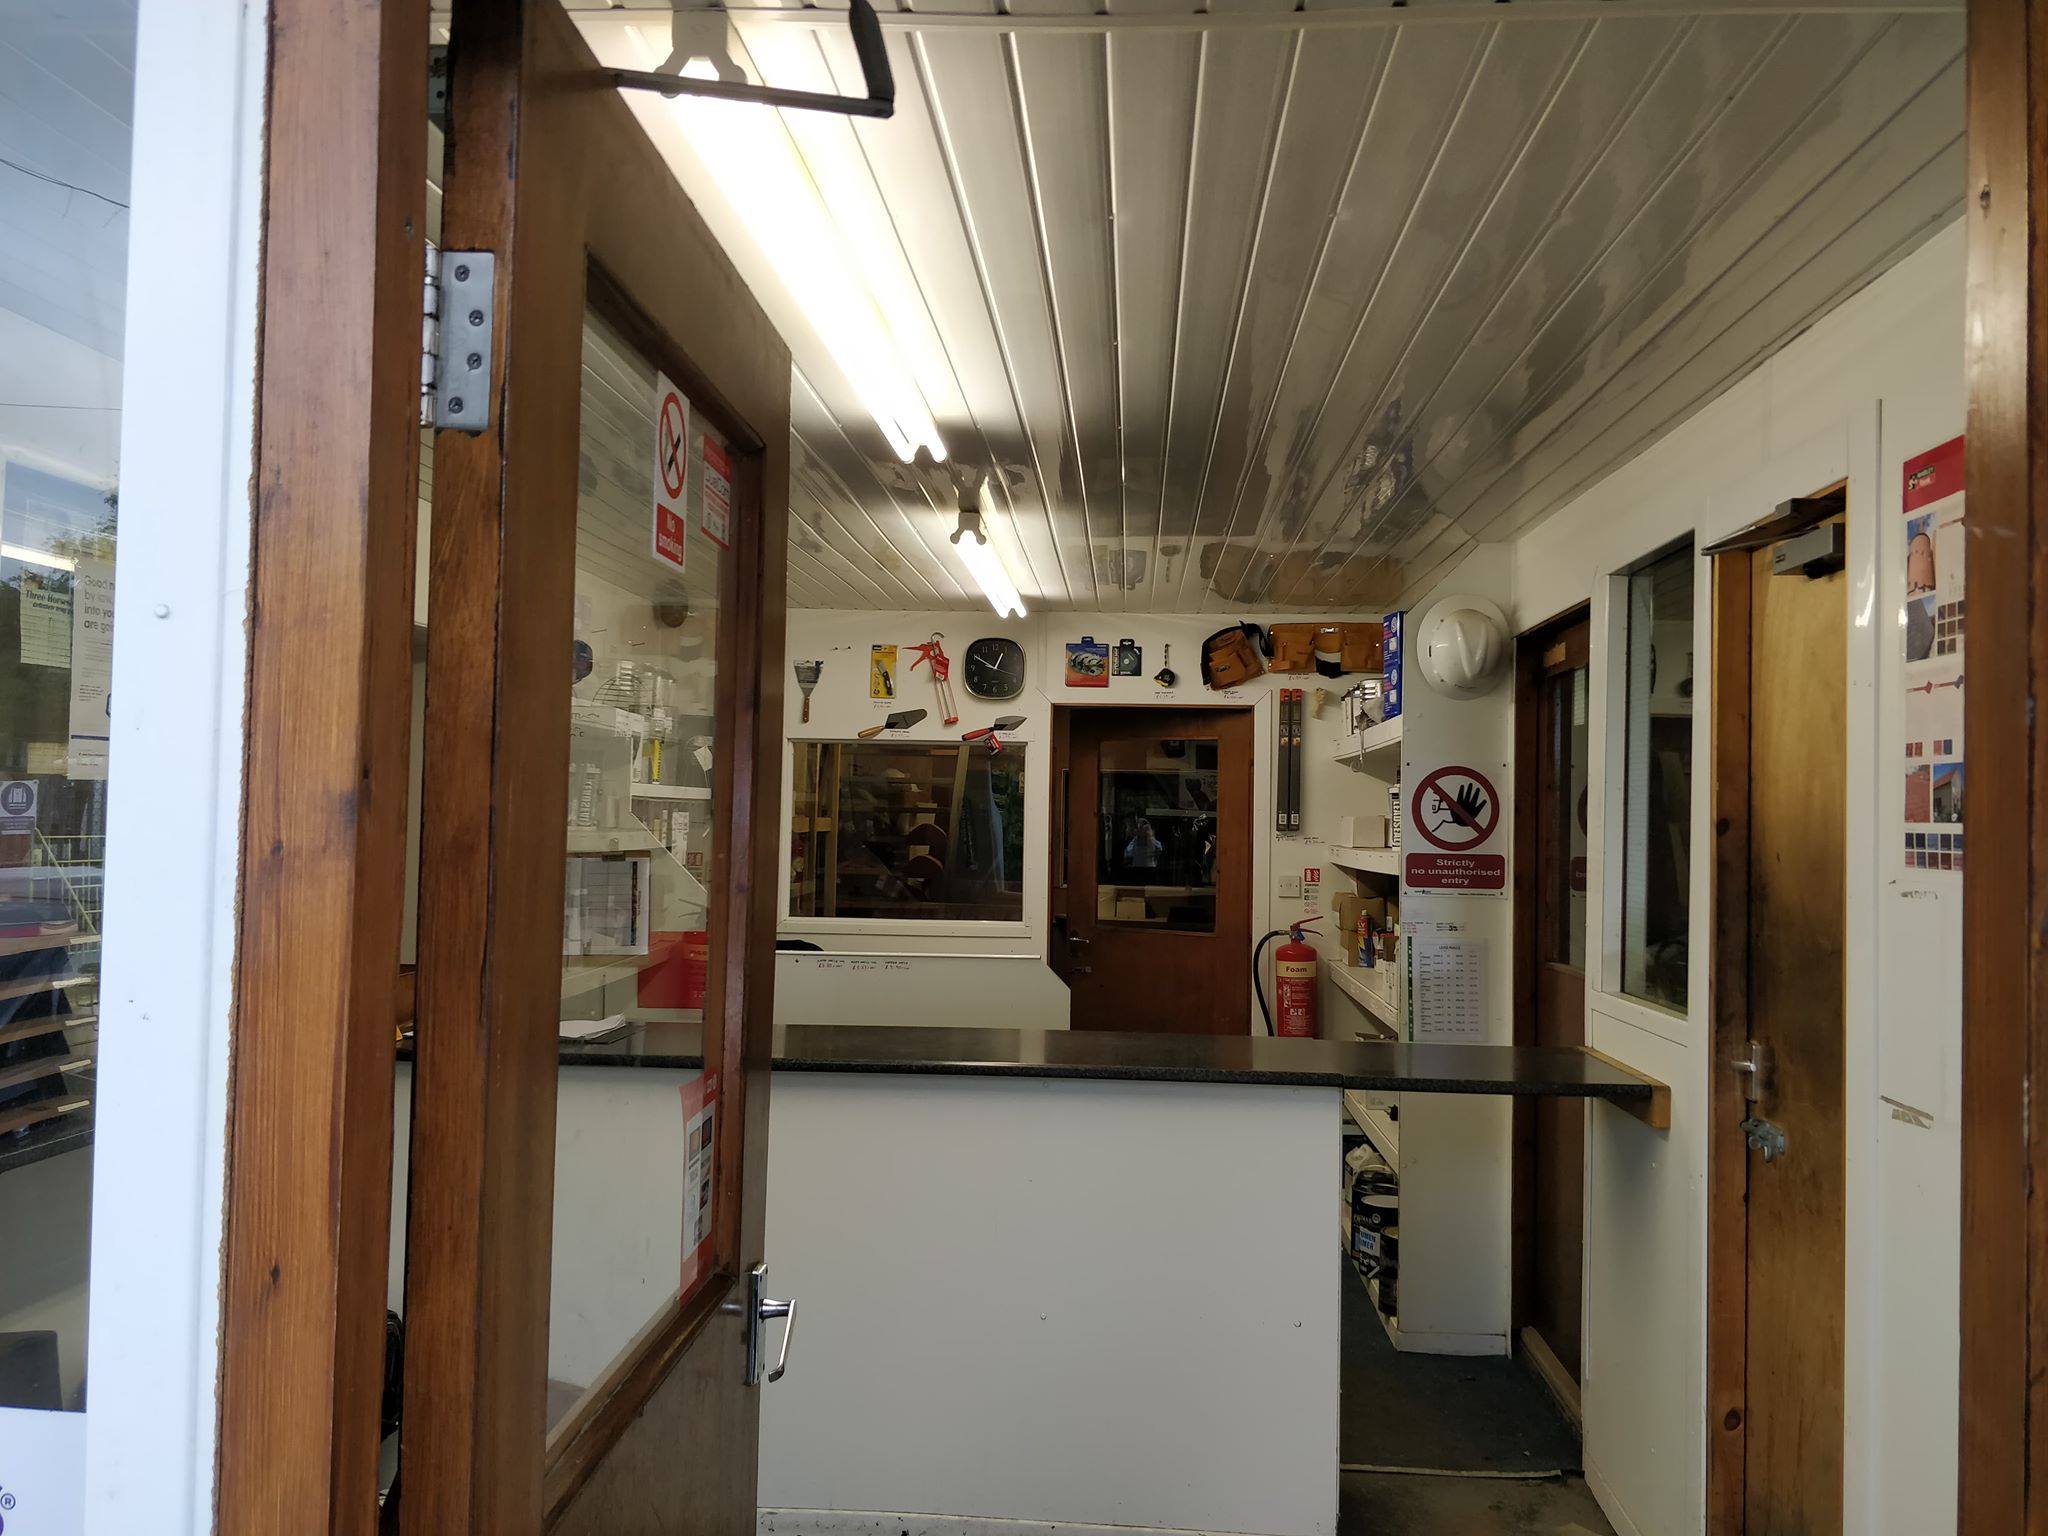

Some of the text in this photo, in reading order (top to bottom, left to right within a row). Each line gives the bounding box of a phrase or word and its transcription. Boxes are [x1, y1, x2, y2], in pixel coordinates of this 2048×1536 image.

[26, 588, 46, 601] Three
[84, 602, 101, 615] into
[83, 619, 99, 630] are
[992, 643, 999, 651] 12
[973, 675, 979, 683] 8
[982, 684, 988, 692] 7
[992, 685, 998, 693] 6
[1435, 858, 1476, 868] Strictly
[1411, 867, 1501, 876] no unauthorised
[1441, 877, 1470, 886] entry
[1285, 965, 1308, 973] Foam
